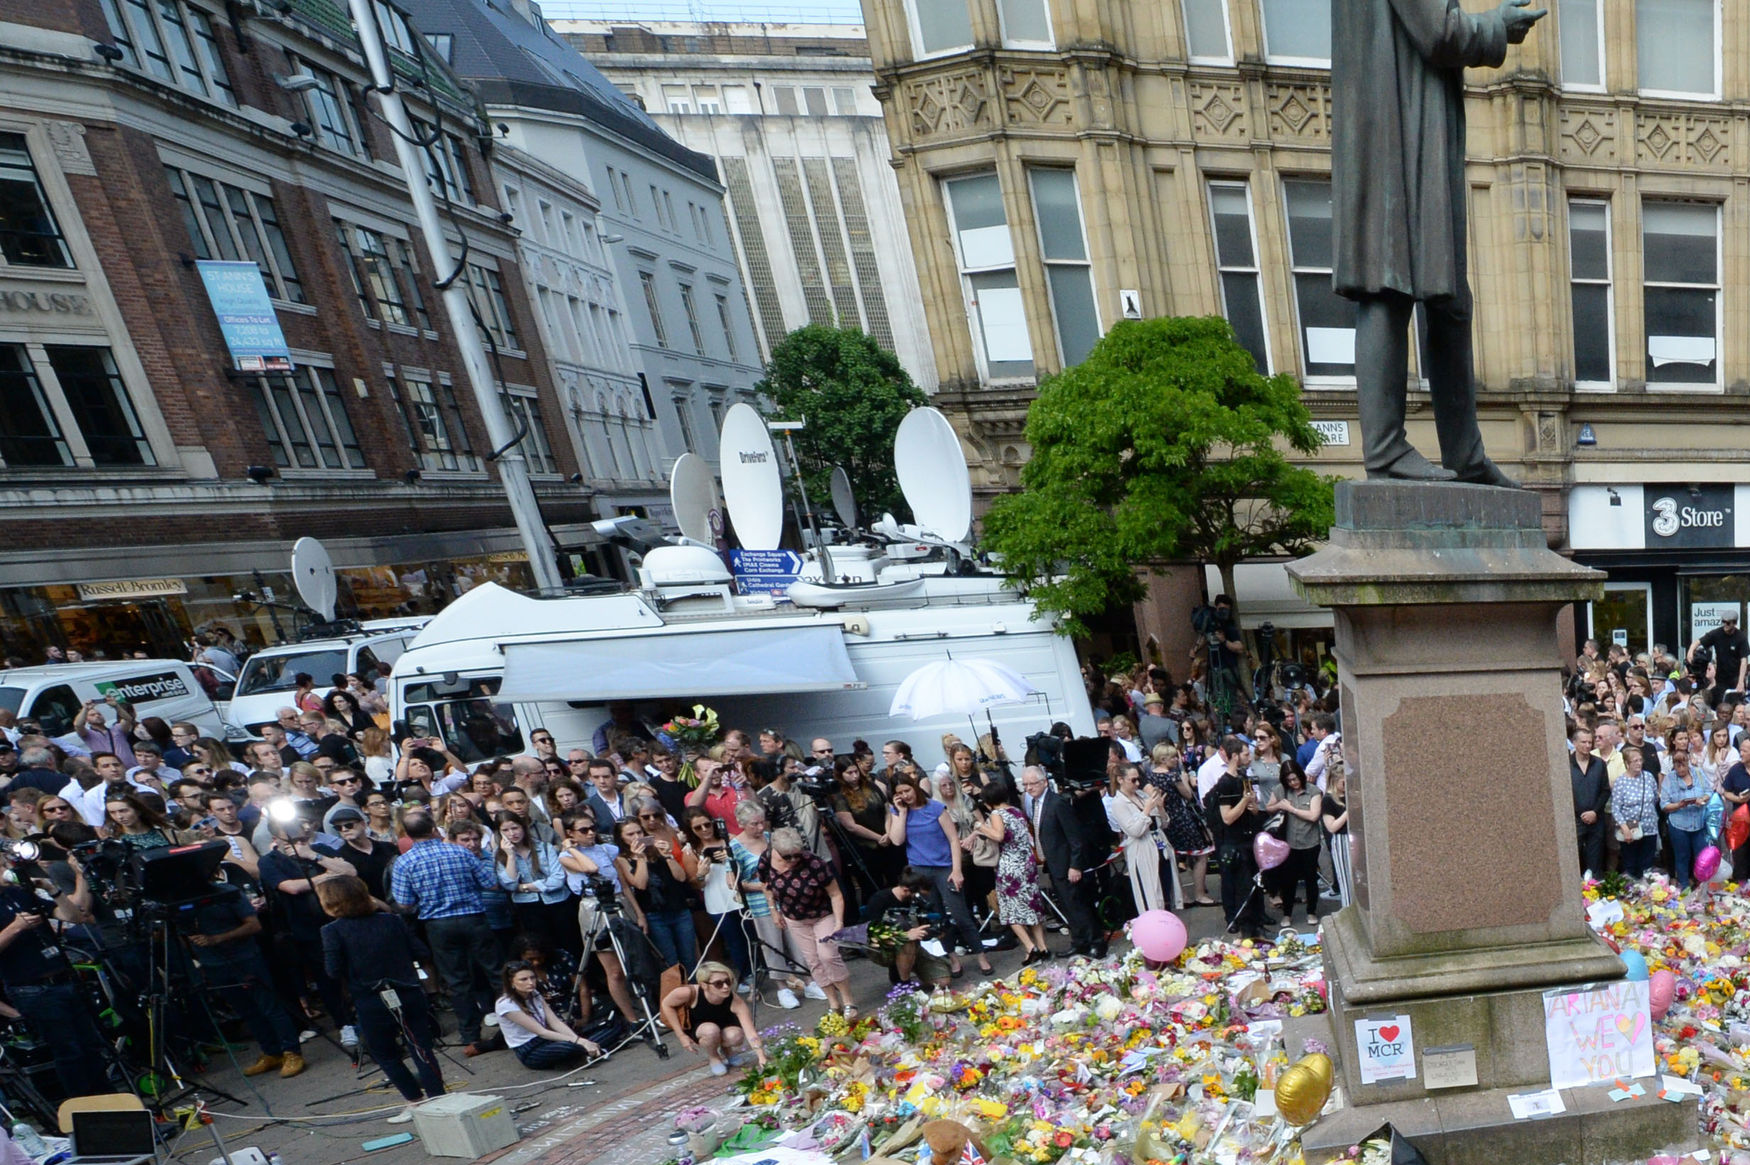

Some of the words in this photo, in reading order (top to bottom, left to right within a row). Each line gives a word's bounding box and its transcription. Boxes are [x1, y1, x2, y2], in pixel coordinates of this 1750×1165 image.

[1652, 497, 1680, 537] 3
[1681, 506, 1723, 527] Store
[79, 583, 126, 597] Russell
[131, 579, 182, 593] Bromley
[1694, 608, 1715, 617] Just
[1694, 618, 1720, 626] amaz
[106, 677, 184, 700] enterprise
[1549, 983, 1641, 1018] ARIANA
[1368, 1028, 1379, 1044] I
[1570, 1014, 1615, 1052] WE
[1368, 1043, 1404, 1058] MCR
[1580, 1050, 1633, 1079] YOU
